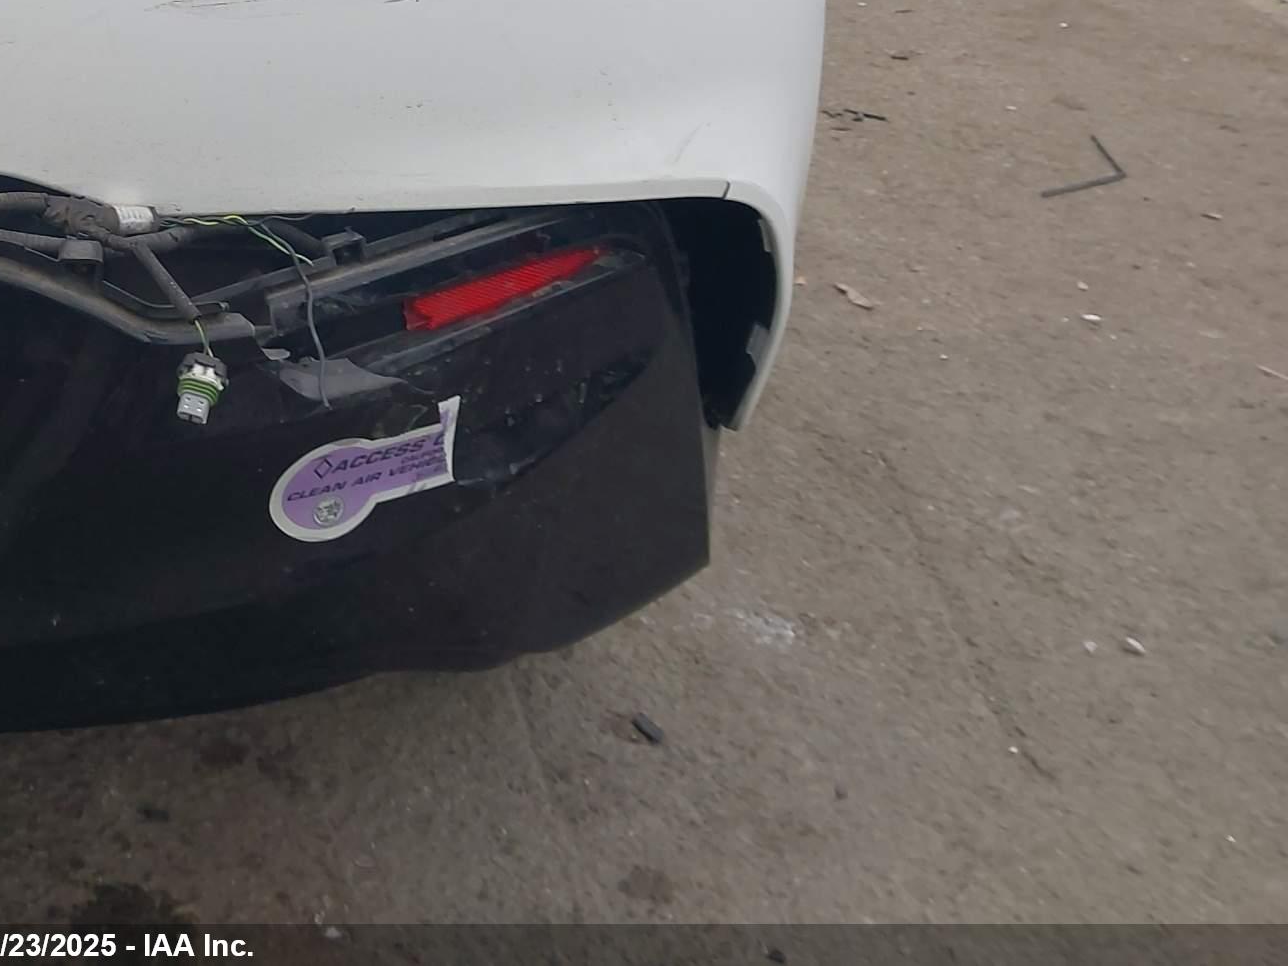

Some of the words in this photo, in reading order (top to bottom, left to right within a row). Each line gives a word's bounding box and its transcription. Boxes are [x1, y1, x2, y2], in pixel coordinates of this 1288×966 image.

[331, 438, 426, 474] ACCESS
[287, 480, 347, 502] CLEAN
[351, 471, 383, 486] AIR
